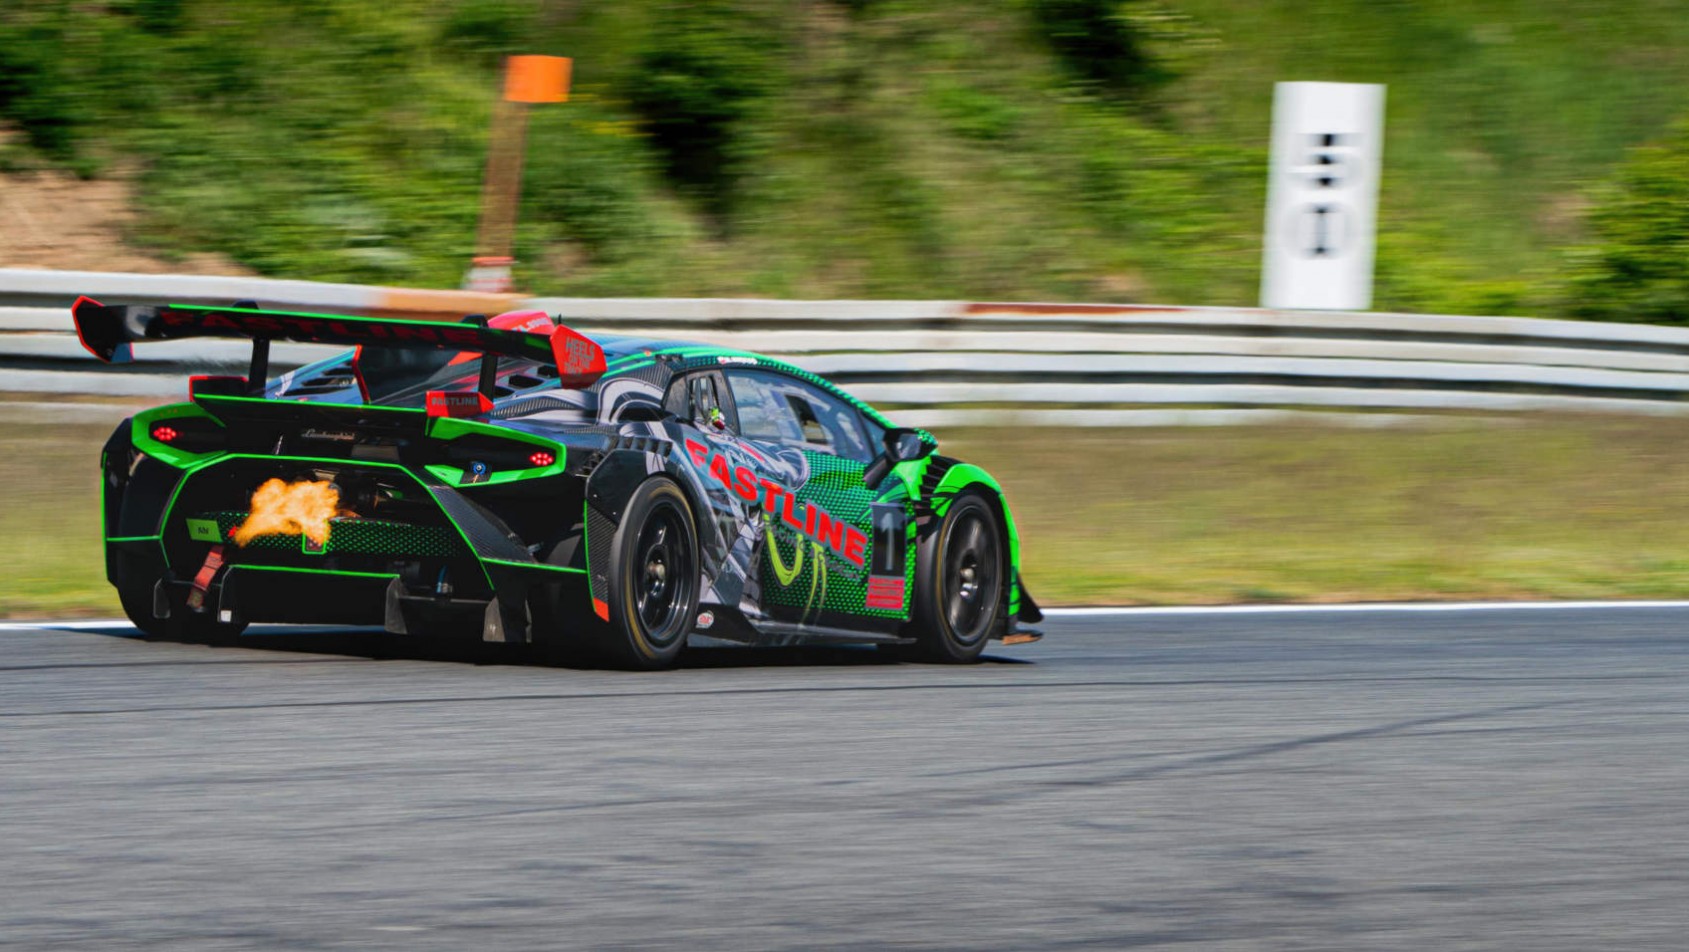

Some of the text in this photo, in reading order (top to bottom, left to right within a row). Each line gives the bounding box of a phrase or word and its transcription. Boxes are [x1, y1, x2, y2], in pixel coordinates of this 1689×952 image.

[162, 312, 480, 344] FASTLINE
[685, 438, 868, 567] FASTLINE
[880, 511, 894, 571] 1
